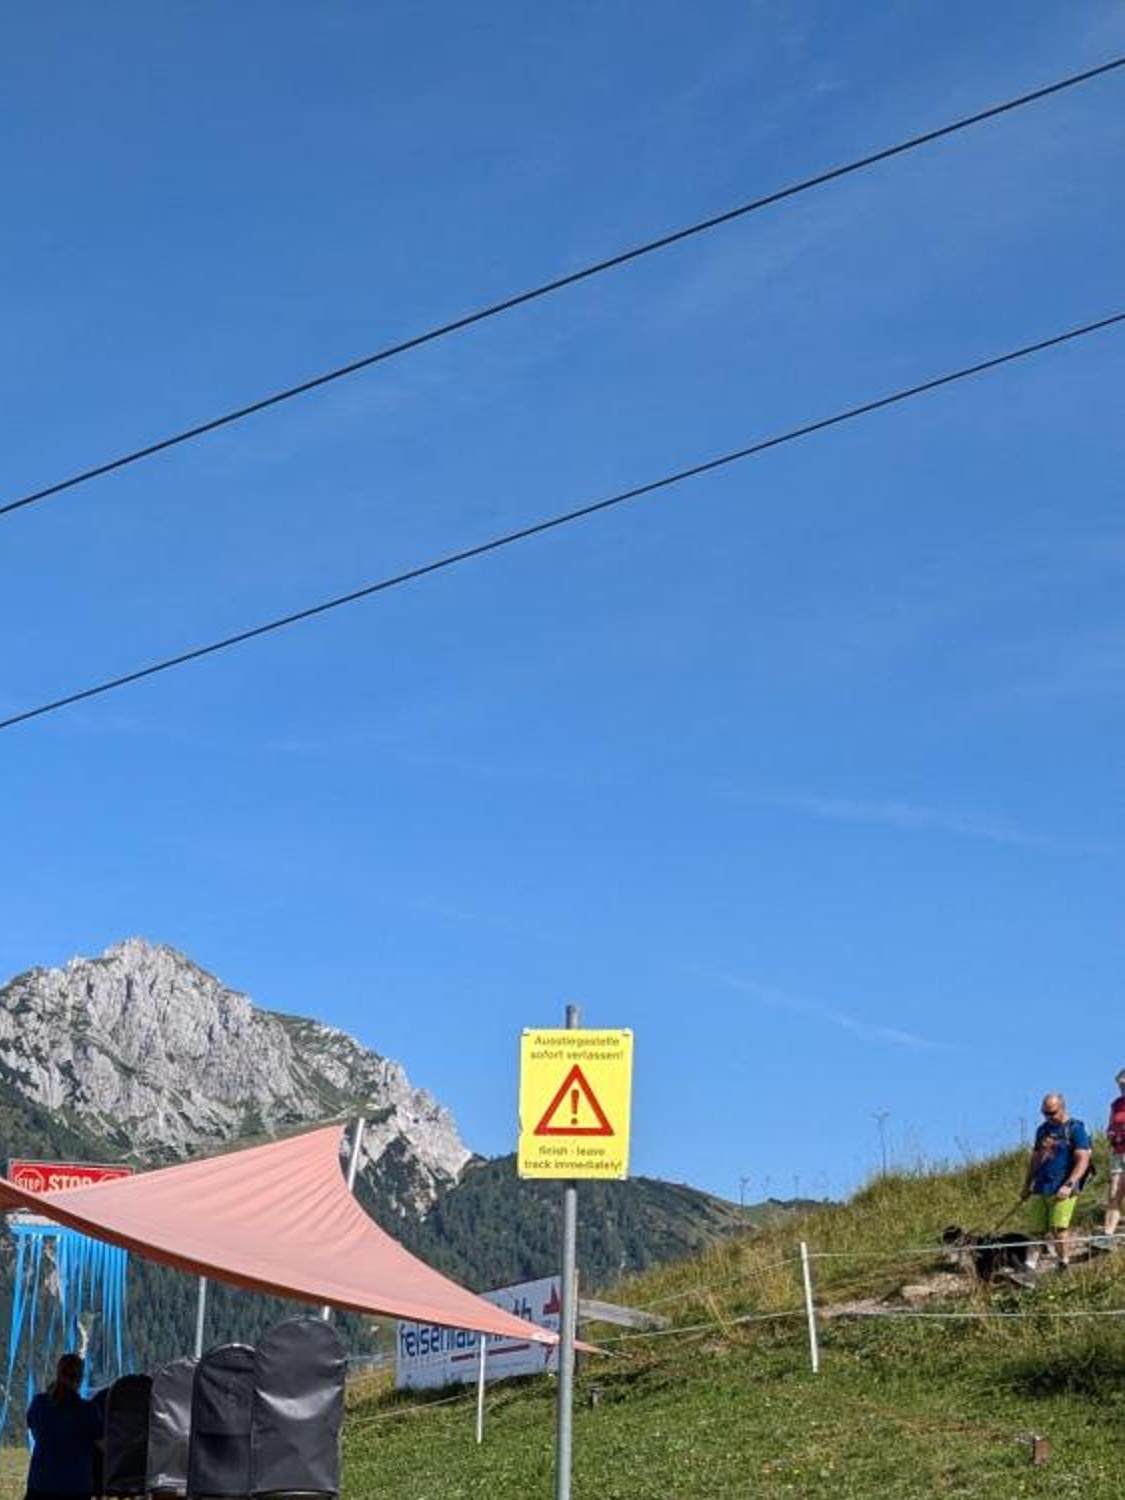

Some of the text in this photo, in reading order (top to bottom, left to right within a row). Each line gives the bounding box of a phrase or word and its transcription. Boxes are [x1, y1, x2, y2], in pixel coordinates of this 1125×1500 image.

[530, 1050, 564, 1060] sofort
[538, 1146, 568, 1156] finish
[576, 1146, 606, 1157] leave
[524, 1160, 551, 1169] track
[48, 1174, 92, 1193] STOP
